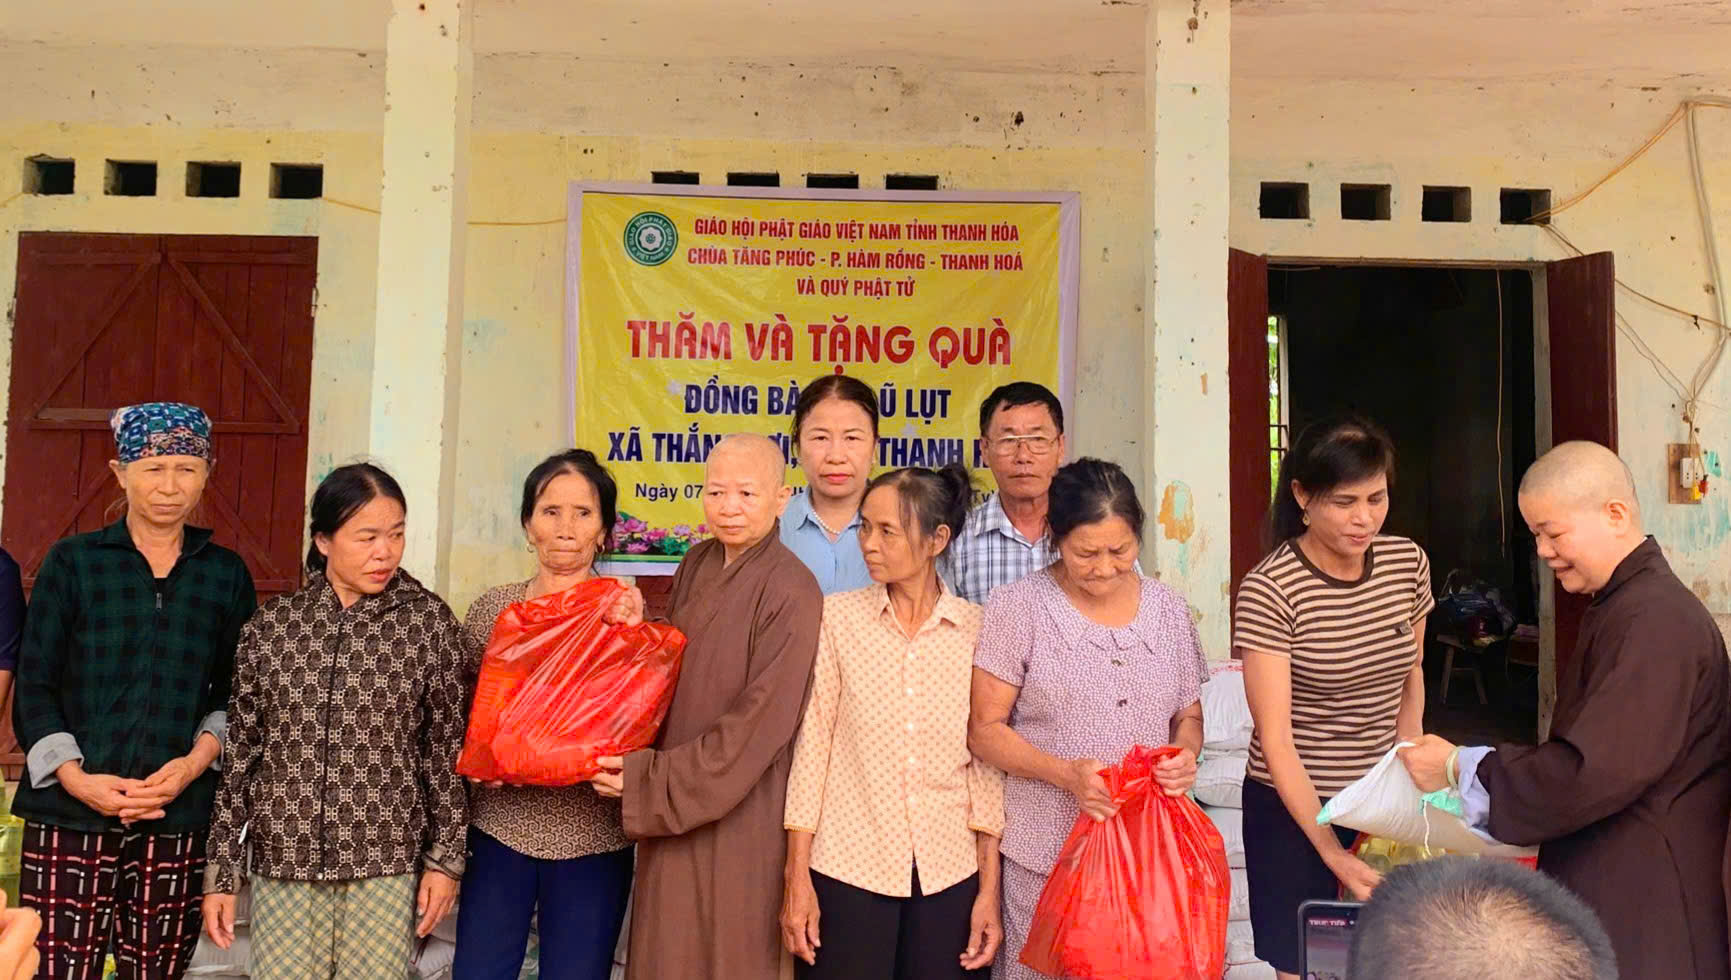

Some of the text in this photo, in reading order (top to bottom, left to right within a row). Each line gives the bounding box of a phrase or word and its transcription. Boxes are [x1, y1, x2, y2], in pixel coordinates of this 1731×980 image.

[694, 216, 1020, 243] GIÁO HỘI PHẬT GIÁO VIỆT NAM TỈNH THANH HÓA
[687, 245, 728, 265] CHÙA
[732, 246, 771, 266] TĂNG
[775, 247, 816, 267] PHÚC
[830, 251, 843, 268] P.
[846, 248, 881, 269] HÀM
[940, 253, 990, 271] THANH
[993, 252, 1024, 272] HOÁ
[796, 275, 916, 300] VÀ QUÝ PHẬT TỬ
[626, 311, 1012, 375] THĂM VÀ TẶNG QUÀ
[684, 375, 952, 425] ĐỒNG BÀ Ũ LỤT
[607, 426, 643, 462] XÃ
[652, 422, 722, 463] THẮN
[879, 437, 964, 467] THANH
[635, 483, 704, 502] Ngày 07
